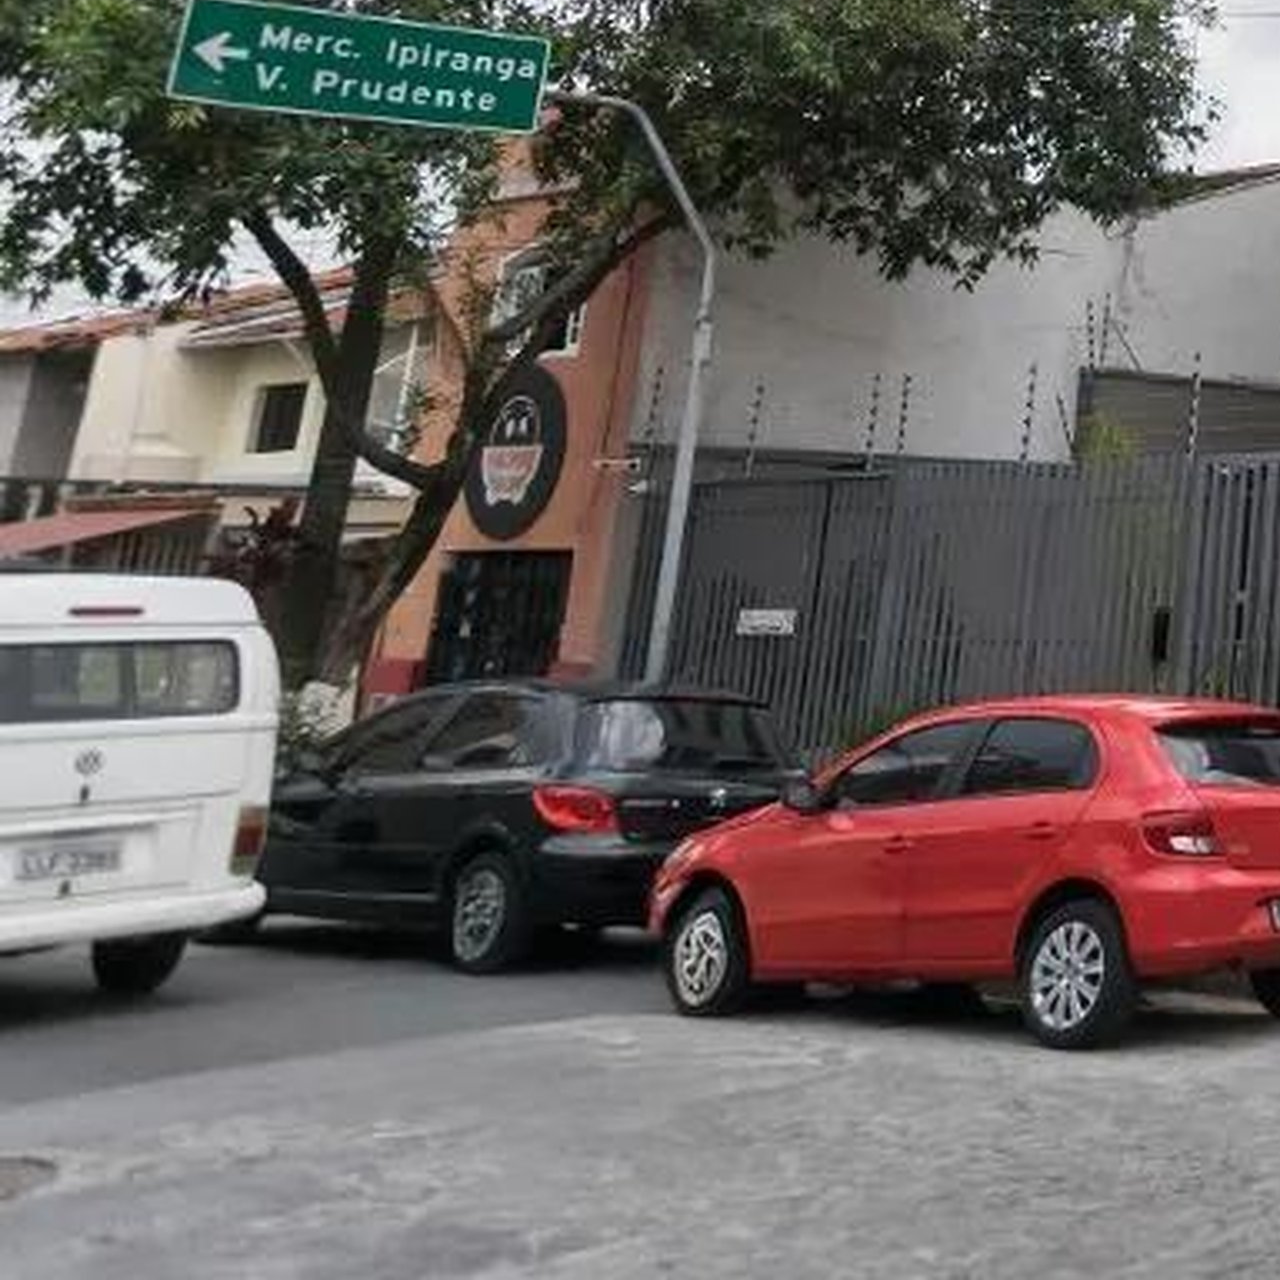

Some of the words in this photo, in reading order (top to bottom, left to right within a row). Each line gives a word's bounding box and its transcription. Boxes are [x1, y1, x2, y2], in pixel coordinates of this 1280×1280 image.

[258, 23, 361, 59] Merc.
[386, 38, 537, 82] Ipiranga
[255, 62, 288, 92] V.
[312, 69, 498, 112] Prudente
